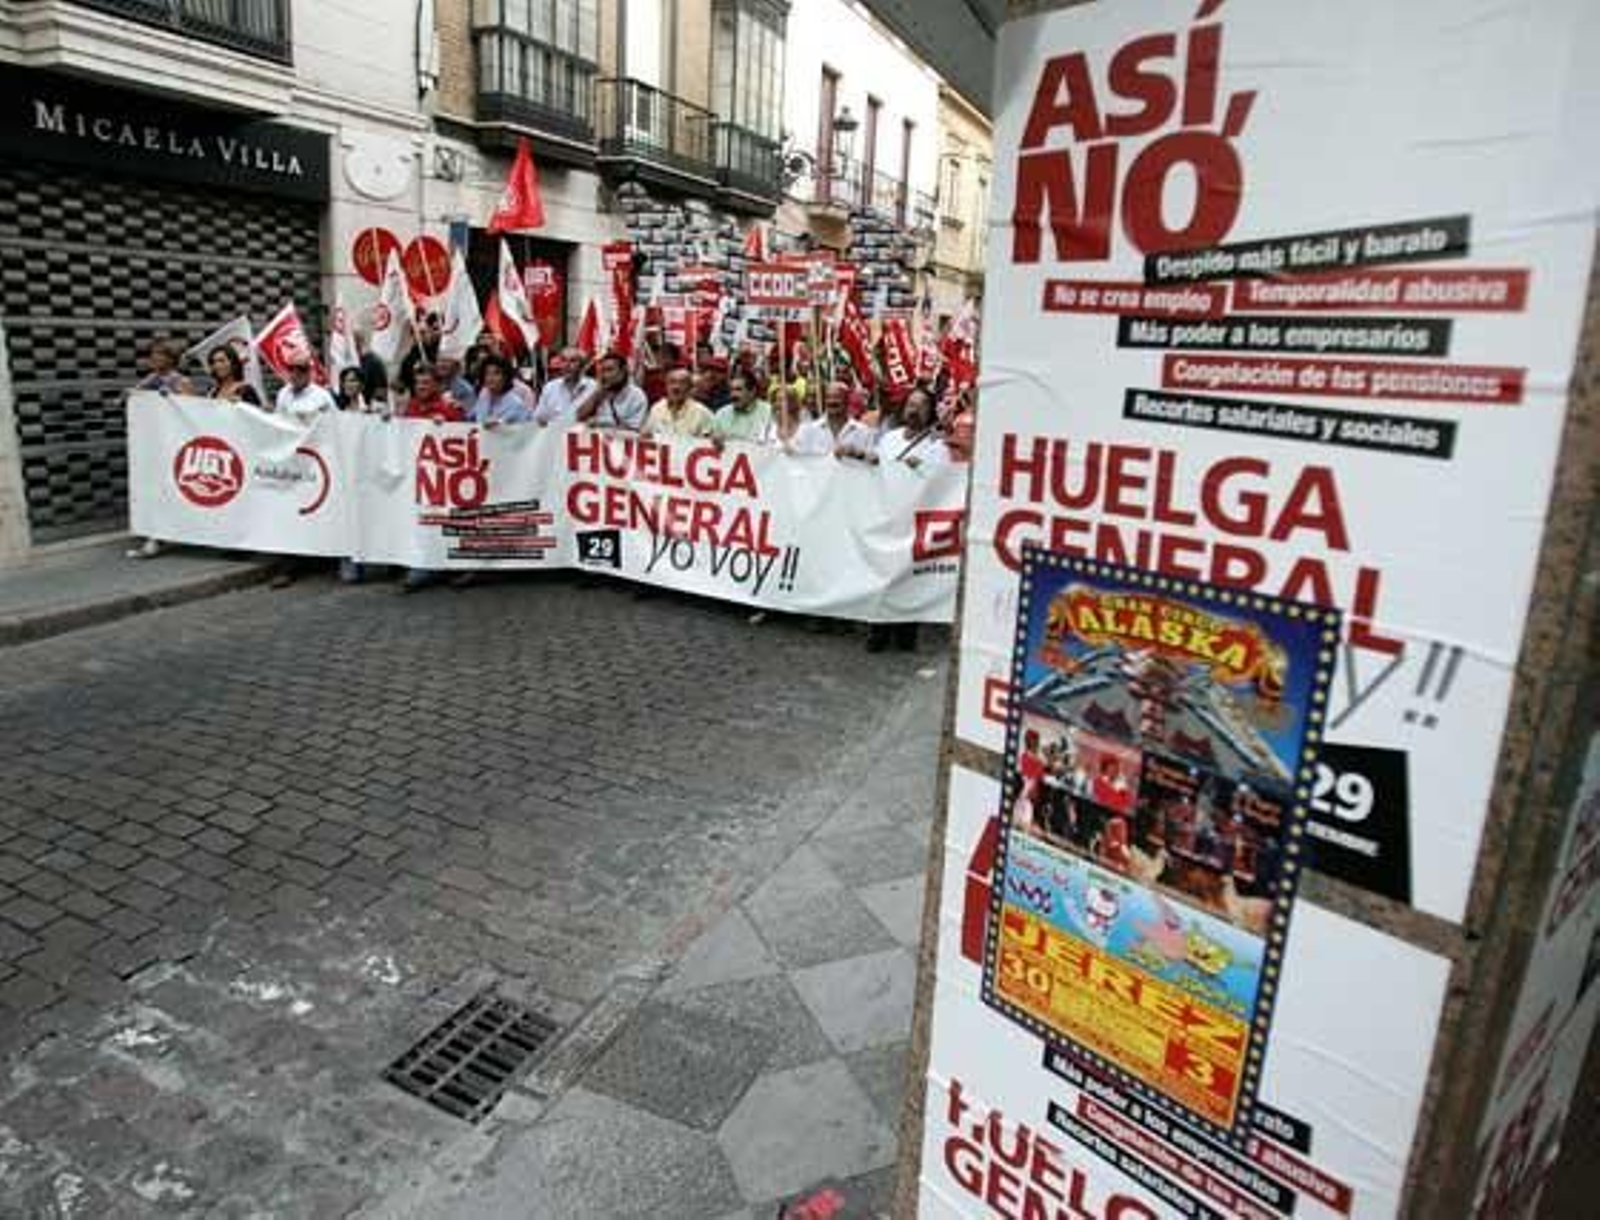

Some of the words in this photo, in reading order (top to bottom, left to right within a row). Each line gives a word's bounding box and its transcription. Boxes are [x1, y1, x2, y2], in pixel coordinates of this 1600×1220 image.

[1019, 0, 1258, 149] ASÍ,
[34, 99, 205, 158] MICAELA
[217, 135, 304, 175] VILLA
[1012, 131, 1243, 263] NO
[1156, 251, 1236, 279] Despido
[1344, 238, 1361, 266] y
[1364, 227, 1449, 257] barato
[1052, 284, 1078, 304] No
[1080, 287, 1101, 306] se
[1102, 288, 1140, 308] crea
[1143, 288, 1213, 314] empleo
[1249, 279, 1400, 309] Temporalidad
[1402, 276, 1509, 304] abusiva
[1128, 319, 1168, 344] Más
[1170, 323, 1227, 347] poder
[1230, 327, 1244, 345] a
[1248, 322, 1281, 346] los
[1285, 323, 1430, 352] empresarios
[1171, 358, 1295, 388] Congelación
[1298, 365, 1327, 388] de
[1370, 369, 1503, 397] pensiones
[1133, 393, 1215, 424] Recortes
[1216, 404, 1317, 435] salariales
[1320, 417, 1338, 440] y
[1338, 419, 1440, 449] sociales
[181, 446, 234, 478] UGT
[415, 467, 489, 508] NO
[567, 432, 758, 498] HUELGA
[998, 433, 1350, 552] HUELGA
[567, 482, 780, 558] GENERAL
[589, 537, 614, 557] 29
[1078, 606, 1248, 669] ALASKA
[1309, 761, 1375, 822] 29
[1003, 951, 1051, 993] 30
[1003, 912, 1245, 1054] JEREZ
[1186, 1049, 1215, 1085] 3
[1253, 1108, 1296, 1141] rato
